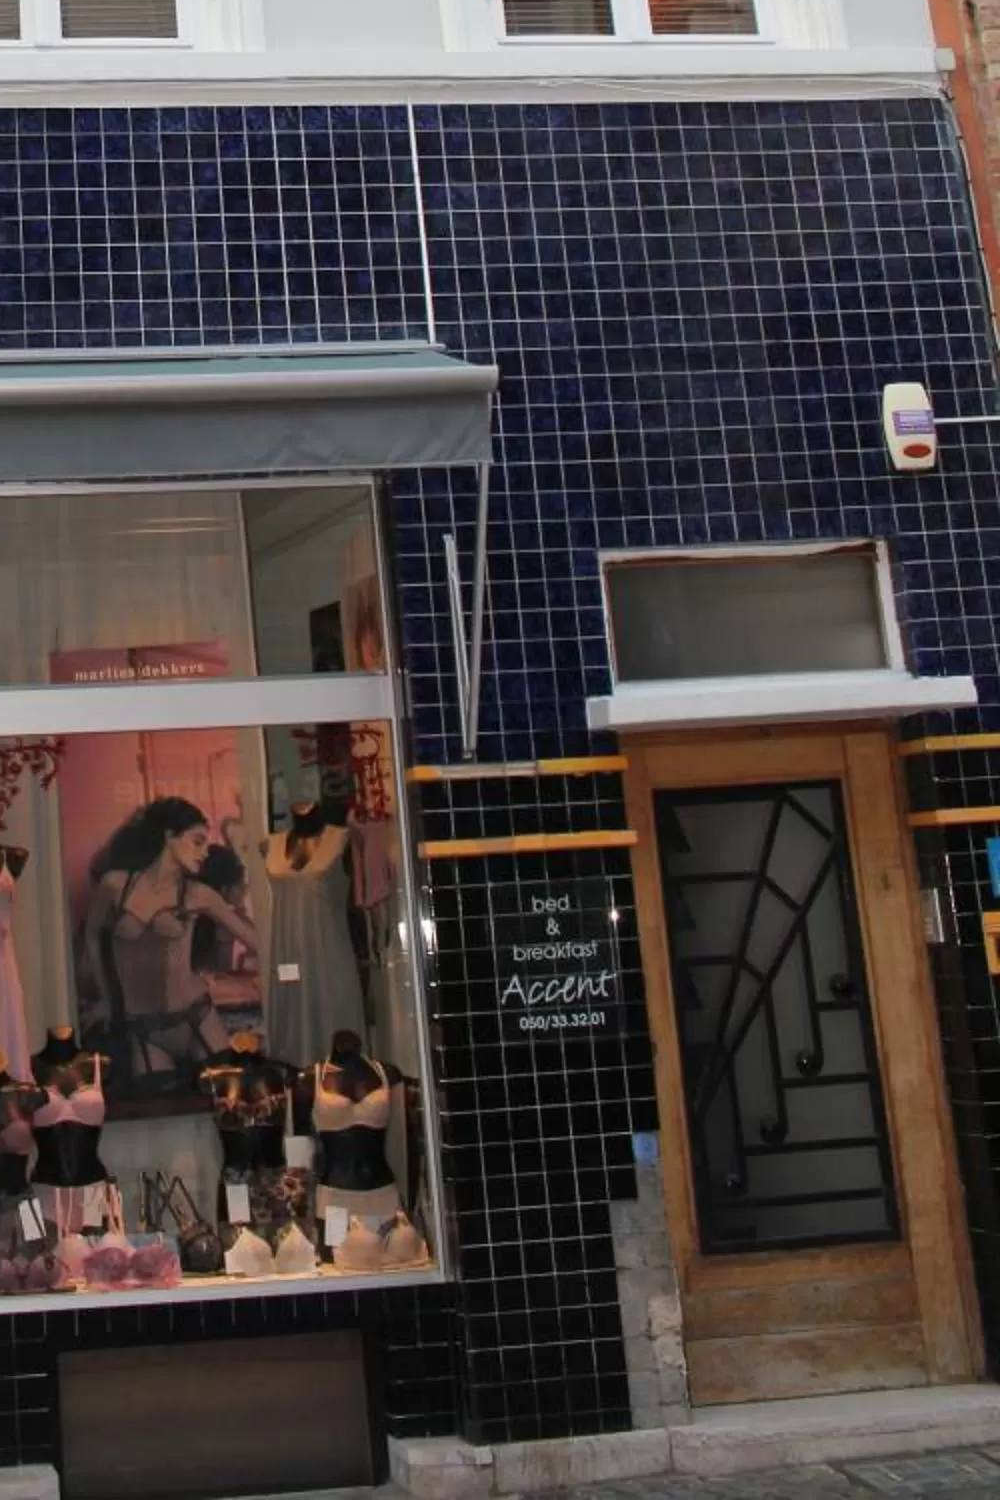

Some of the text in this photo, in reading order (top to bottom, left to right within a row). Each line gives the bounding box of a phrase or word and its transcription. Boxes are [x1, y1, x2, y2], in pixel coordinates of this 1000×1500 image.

[74, 662, 206, 682] marlies dekkers
[531, 893, 570, 914] bed
[545, 916, 561, 936] &
[512, 939, 598, 962] breakfast
[500, 969, 617, 1005] Accent
